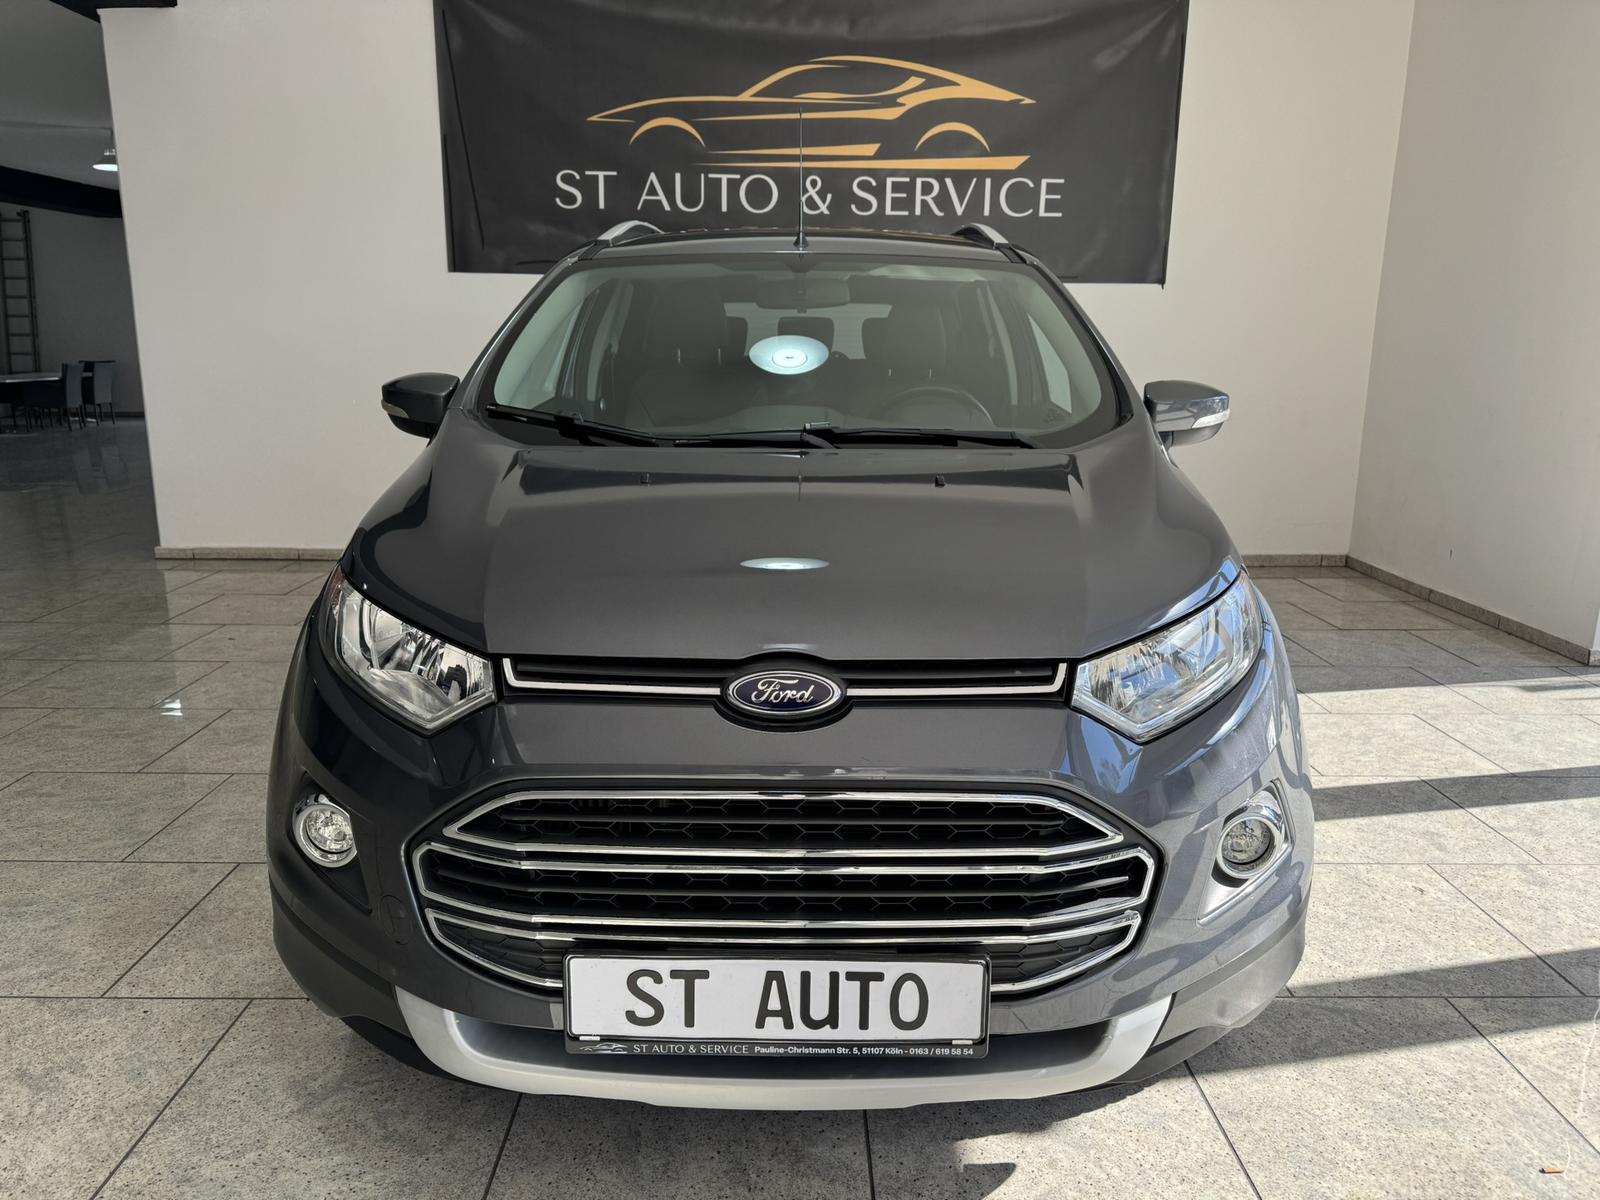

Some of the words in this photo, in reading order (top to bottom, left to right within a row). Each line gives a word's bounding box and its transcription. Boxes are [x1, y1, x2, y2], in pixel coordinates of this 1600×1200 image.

[555, 169, 618, 210] ST
[637, 171, 779, 214] AUTO
[801, 175, 832, 215] &
[850, 176, 1065, 217] SERVICE
[751, 678, 815, 704] Ford
[625, 969, 710, 1028] ST
[755, 970, 929, 1031] AUTO
[633, 1044, 648, 1053] ST
[651, 1044, 684, 1053] AUTO
[688, 1044, 697, 1053] &
[700, 1044, 749, 1054] SERVICE
[754, 1046, 835, 1054] Pauline-Christmann
[837, 1046, 851, 1054] Str.
[862, 1047, 884, 1055] 51107
[885, 1047, 904, 1055] Köln
